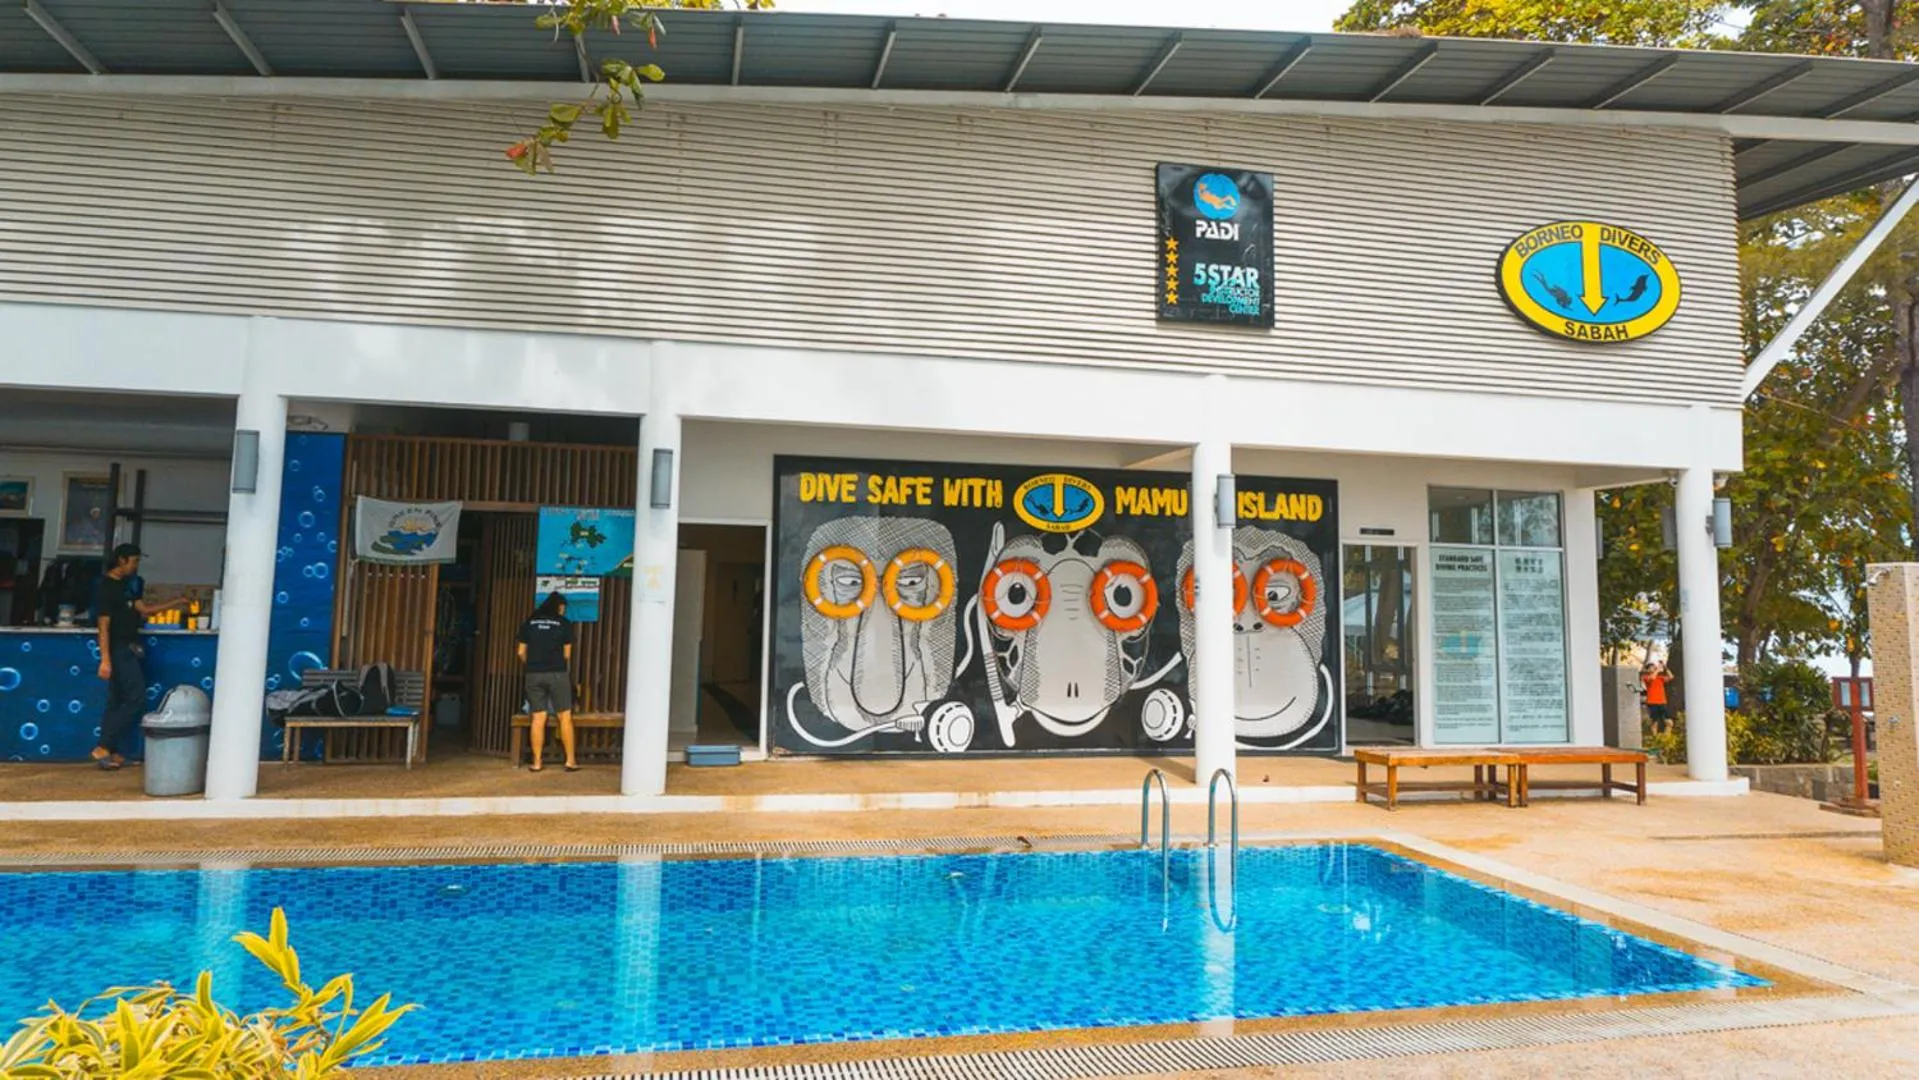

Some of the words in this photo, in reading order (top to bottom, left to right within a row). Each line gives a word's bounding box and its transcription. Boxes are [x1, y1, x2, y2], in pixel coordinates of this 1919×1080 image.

[1195, 219, 1240, 241] PADI
[1514, 224, 1584, 259] BORNEO
[1600, 226, 1662, 265] DIVERS
[1564, 321, 1629, 341] SABAH
[800, 472, 859, 503] DIVE
[866, 474, 934, 505] SAFE
[943, 477, 1004, 508] WITH
[1115, 486, 1189, 517] MAMU
[1237, 490, 1323, 522] ISLAND
